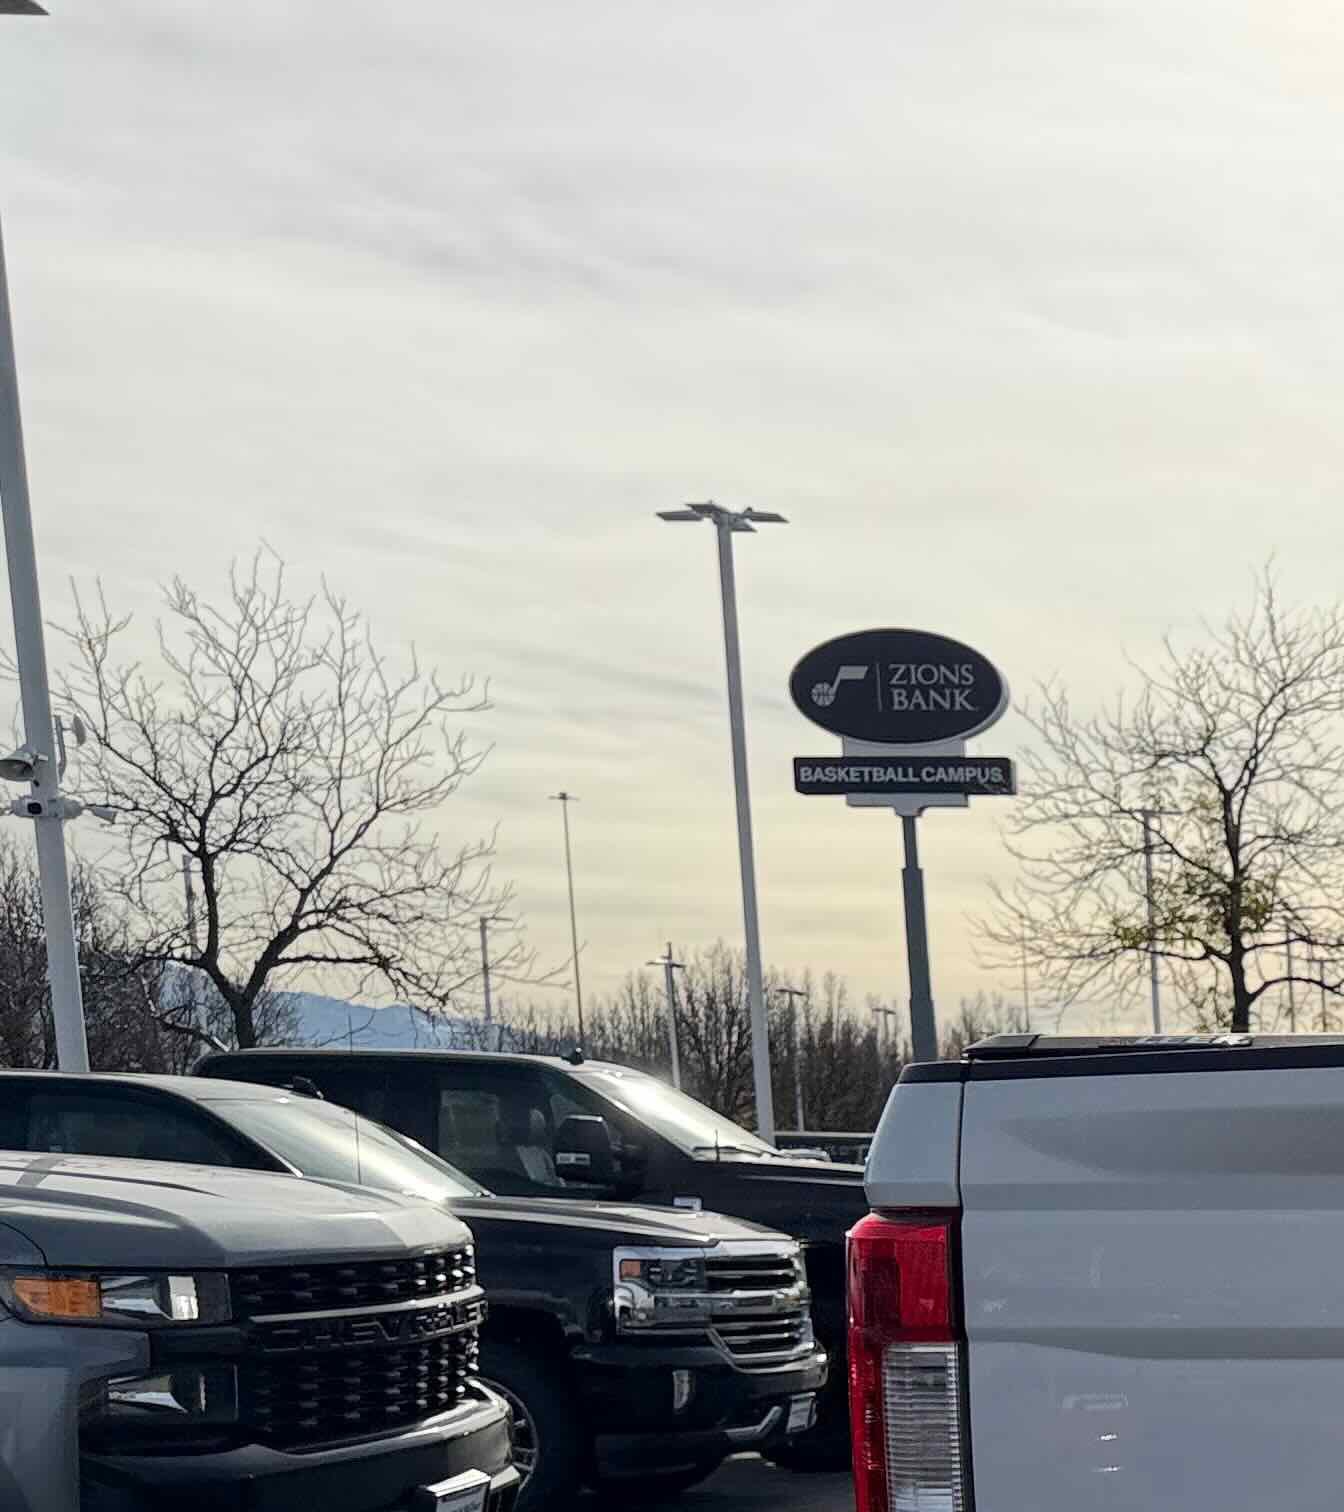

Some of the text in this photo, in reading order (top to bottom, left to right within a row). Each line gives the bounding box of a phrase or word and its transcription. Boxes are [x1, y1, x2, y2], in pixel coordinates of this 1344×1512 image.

[888, 663, 974, 686] ZIONS
[892, 689, 976, 711] BANK
[800, 766, 1003, 783] BASKETBALL CAMPUS
